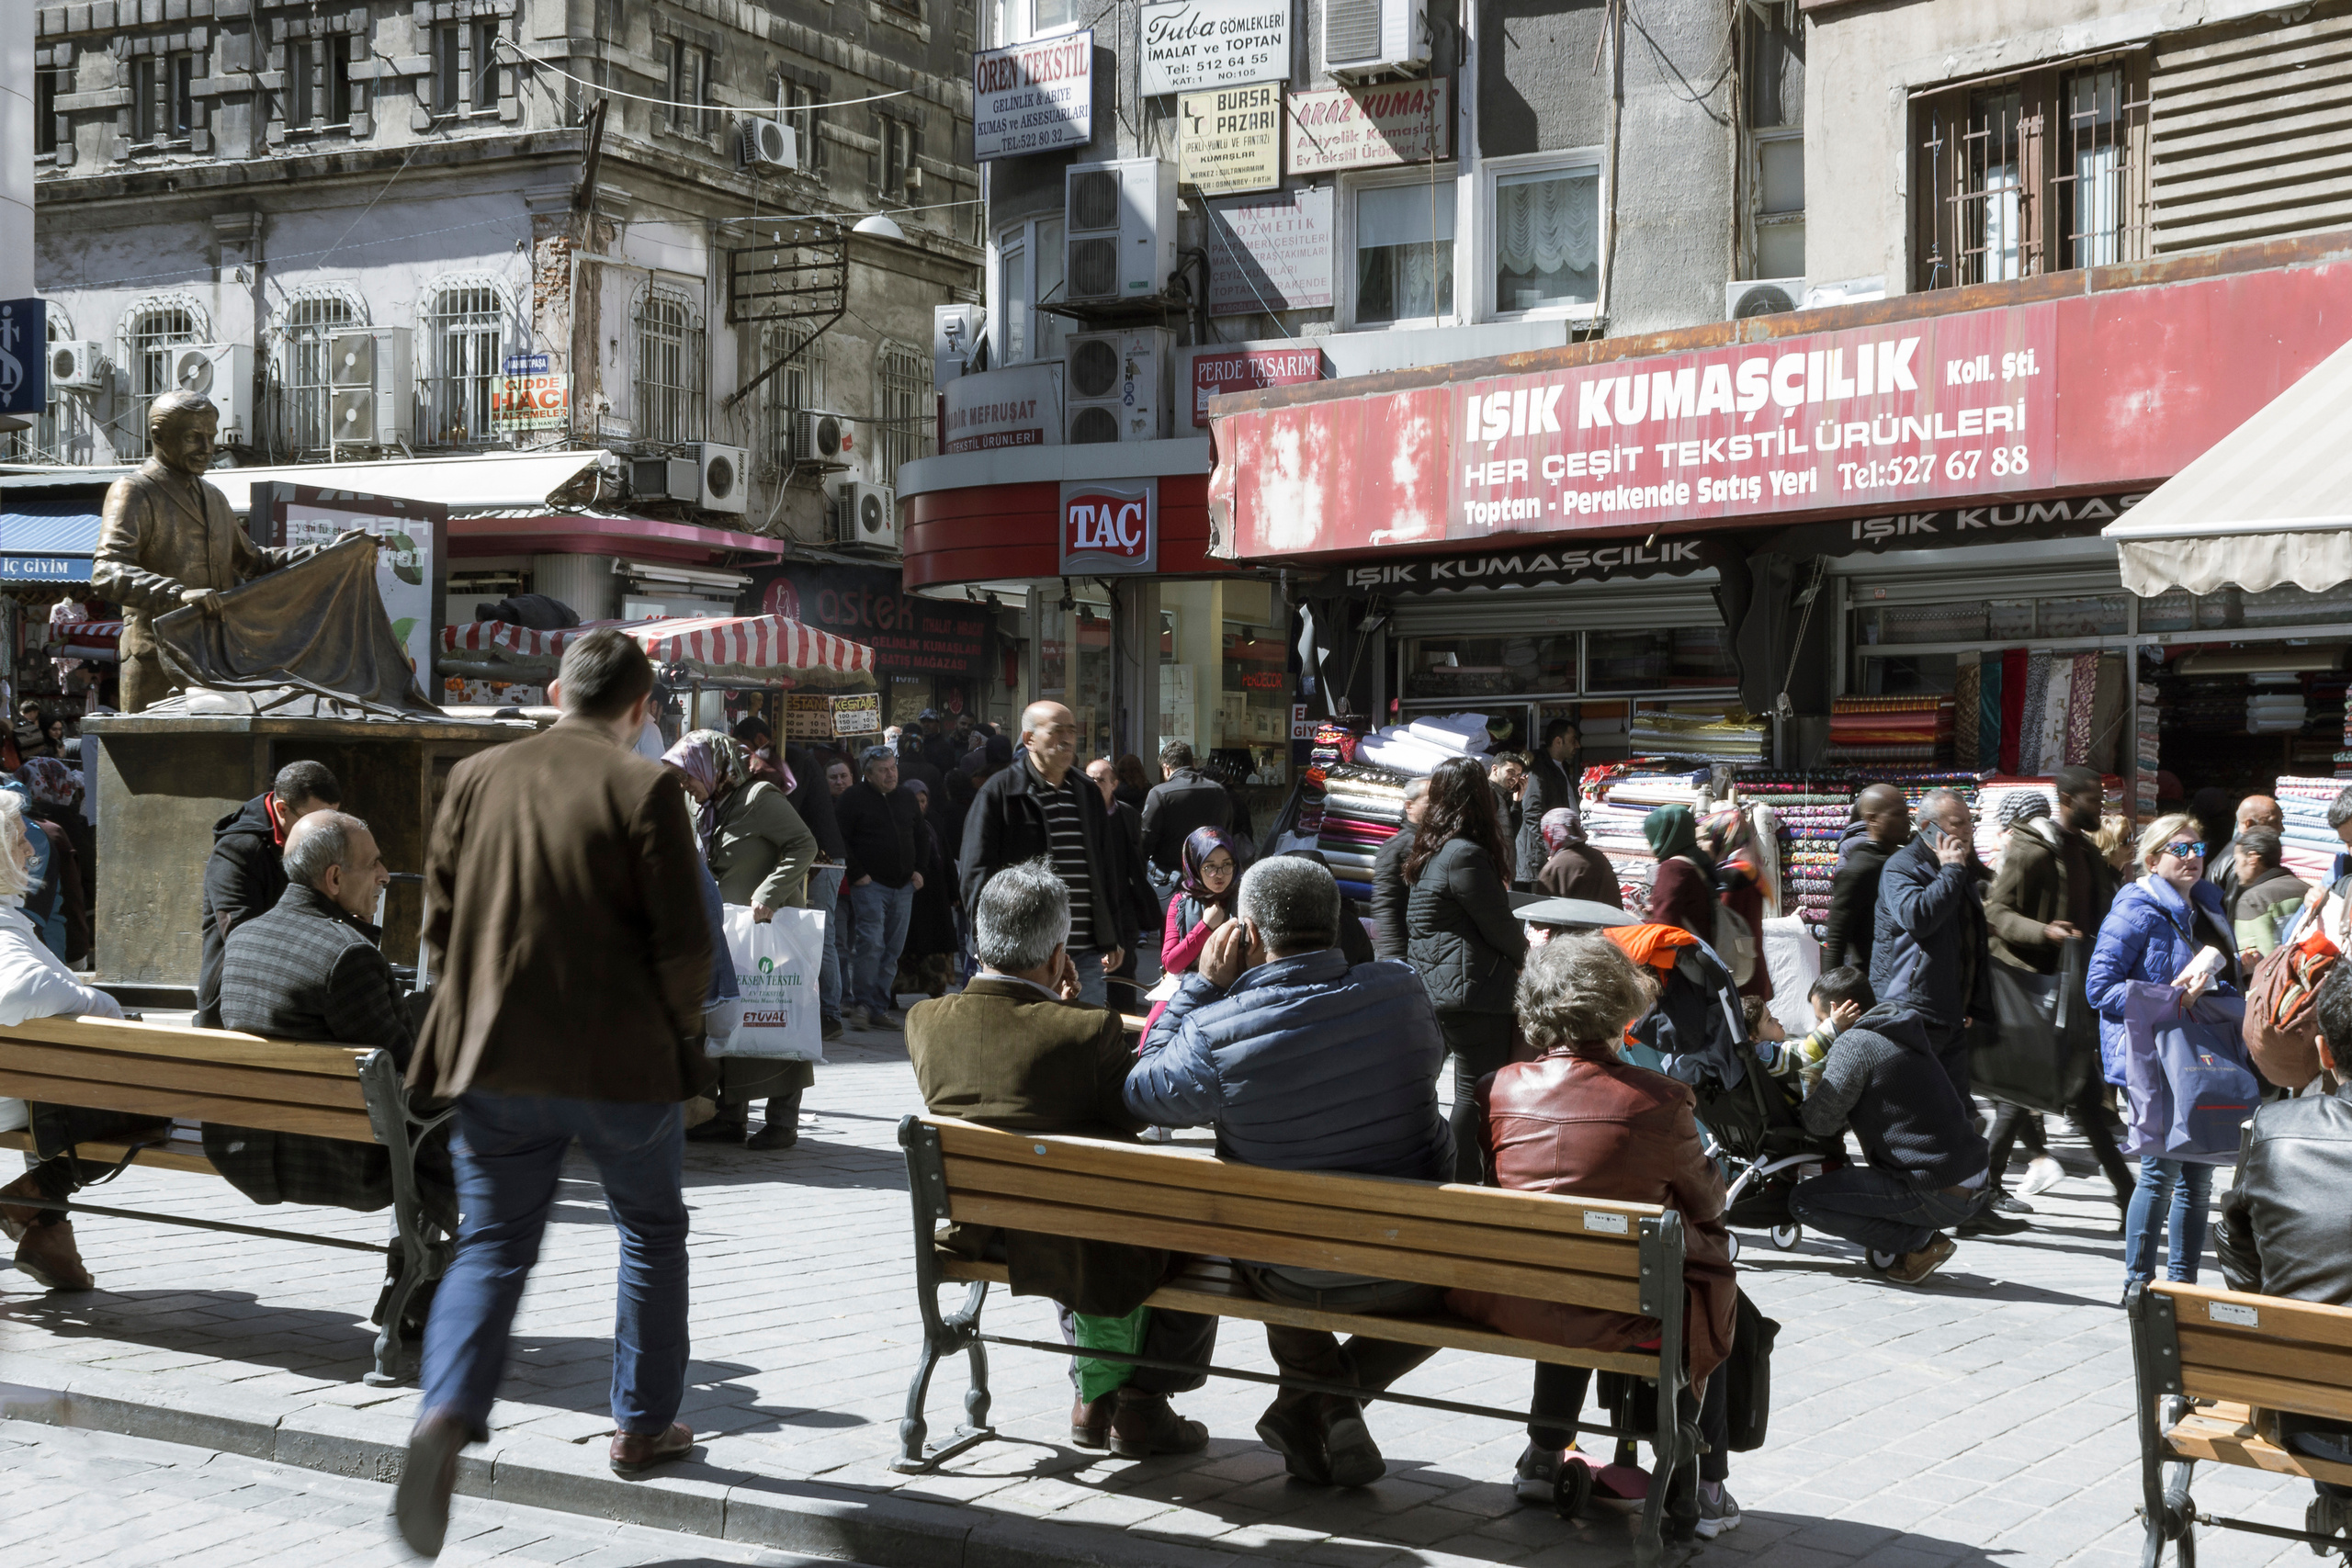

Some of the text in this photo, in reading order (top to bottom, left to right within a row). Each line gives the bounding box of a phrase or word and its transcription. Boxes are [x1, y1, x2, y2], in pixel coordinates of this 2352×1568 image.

[1147, 4, 1284, 45] Tuba GÖMLEKLERİ
[1148, 33, 1282, 62] İMALAT ve TOPTAN
[977, 54, 1019, 96] ÖREN
[1166, 53, 1268, 75] Tel: 512 64 55
[1217, 69, 1256, 80] NO:105
[993, 87, 1071, 114] GELİNLİK & ABİYE
[1217, 88, 1270, 112] BURSA
[1296, 88, 1441, 128] ARAZ KUMAŞ
[978, 104, 1089, 136] KUMAŞ ve AKSESUARLARI
[1217, 111, 1274, 134] PAZARI
[1001, 129, 1063, 152] TEL:522 80 32
[1231, 137, 1239, 147] VE
[1297, 121, 1442, 150] Abiyelik Kumaşlar
[1200, 151, 1255, 164] KUMAŞLAR
[1296, 142, 1415, 166] Ev Tekstil Ürünleri
[1238, 196, 1303, 221] METİN
[1226, 216, 1315, 238] KOZMETİK
[1274, 231, 1329, 249] ÇEŞİTLERİ
[1255, 253, 1278, 262] TRAŞ
[1281, 246, 1328, 259] TAKIMLARI
[1245, 265, 1297, 278] KUTULARI
[1214, 277, 1327, 296] TOPTAN PERAKENDE
[1198, 355, 1316, 382] PERDE TASARIM
[1255, 378, 1276, 389] VE
[1465, 336, 2040, 451] IŞIK KUMAŞÇILIK Koll. Şti.
[492, 389, 568, 412] HACI
[969, 400, 1036, 426] MEFRUŞAT
[954, 436, 979, 453] TEKSTİL
[982, 429, 1035, 447] ÜRÜNLERİ
[1464, 397, 2026, 488] HER ÇEŞİT TEKSTİL ÜRÜNLERİ
[1464, 496, 1541, 526] Toptan
[1563, 479, 1690, 515] Perakende
[1697, 473, 1761, 504] Satış
[1769, 466, 1817, 497] Yeri
[1838, 454, 1937, 491] Tel:527
[1945, 449, 1982, 480] 67
[1990, 445, 2030, 477] 88
[296, 521, 315, 534] yeni
[1852, 513, 1939, 544] IŞIK
[4, 558, 69, 575] İÇ GİYİM
[1346, 540, 1702, 592] IŞIK KUMAŞÇILIK
[819, 582, 913, 631] astek
[922, 639, 981, 656] KUMAŞLARI
[913, 655, 967, 671] MAĞAZASI
[834, 698, 876, 711] KESTANE
[766, 973, 802, 986] TEKSTİL
[743, 1011, 786, 1022] ETUVAL
